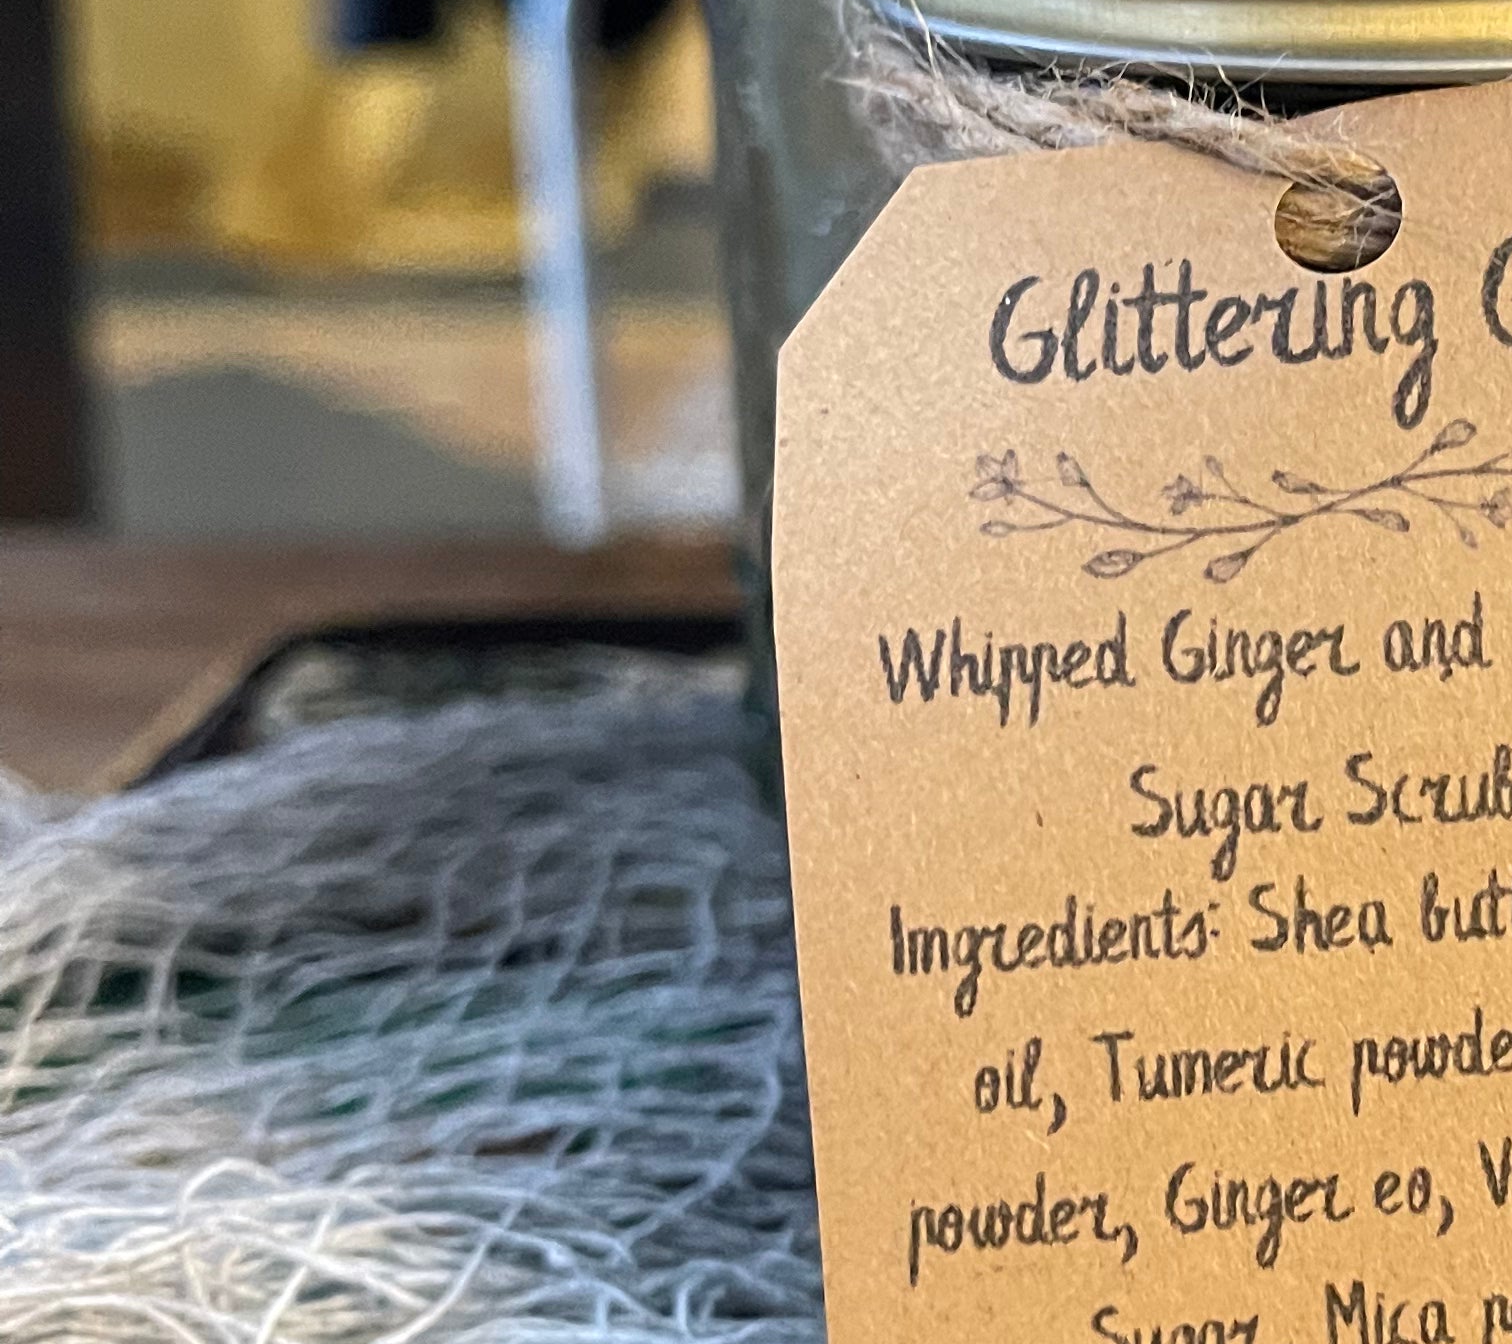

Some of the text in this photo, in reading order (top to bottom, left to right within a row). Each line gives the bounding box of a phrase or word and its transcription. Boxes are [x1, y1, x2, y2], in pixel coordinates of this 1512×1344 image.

[987, 257, 1438, 430] Glittering
[877, 609, 1137, 729] Whipped
[1160, 607, 1361, 730] Ginger
[1383, 590, 1493, 683] and
[1129, 764, 1325, 886] Sugar
[1248, 873, 1394, 955] Shea
[973, 1034, 1068, 1137] oil,
[1090, 1029, 1327, 1104] Tumeric
[908, 1171, 1140, 1289] powder,
[1164, 1160, 1356, 1272] Ginger
[1372, 1166, 1455, 1238] eo,
